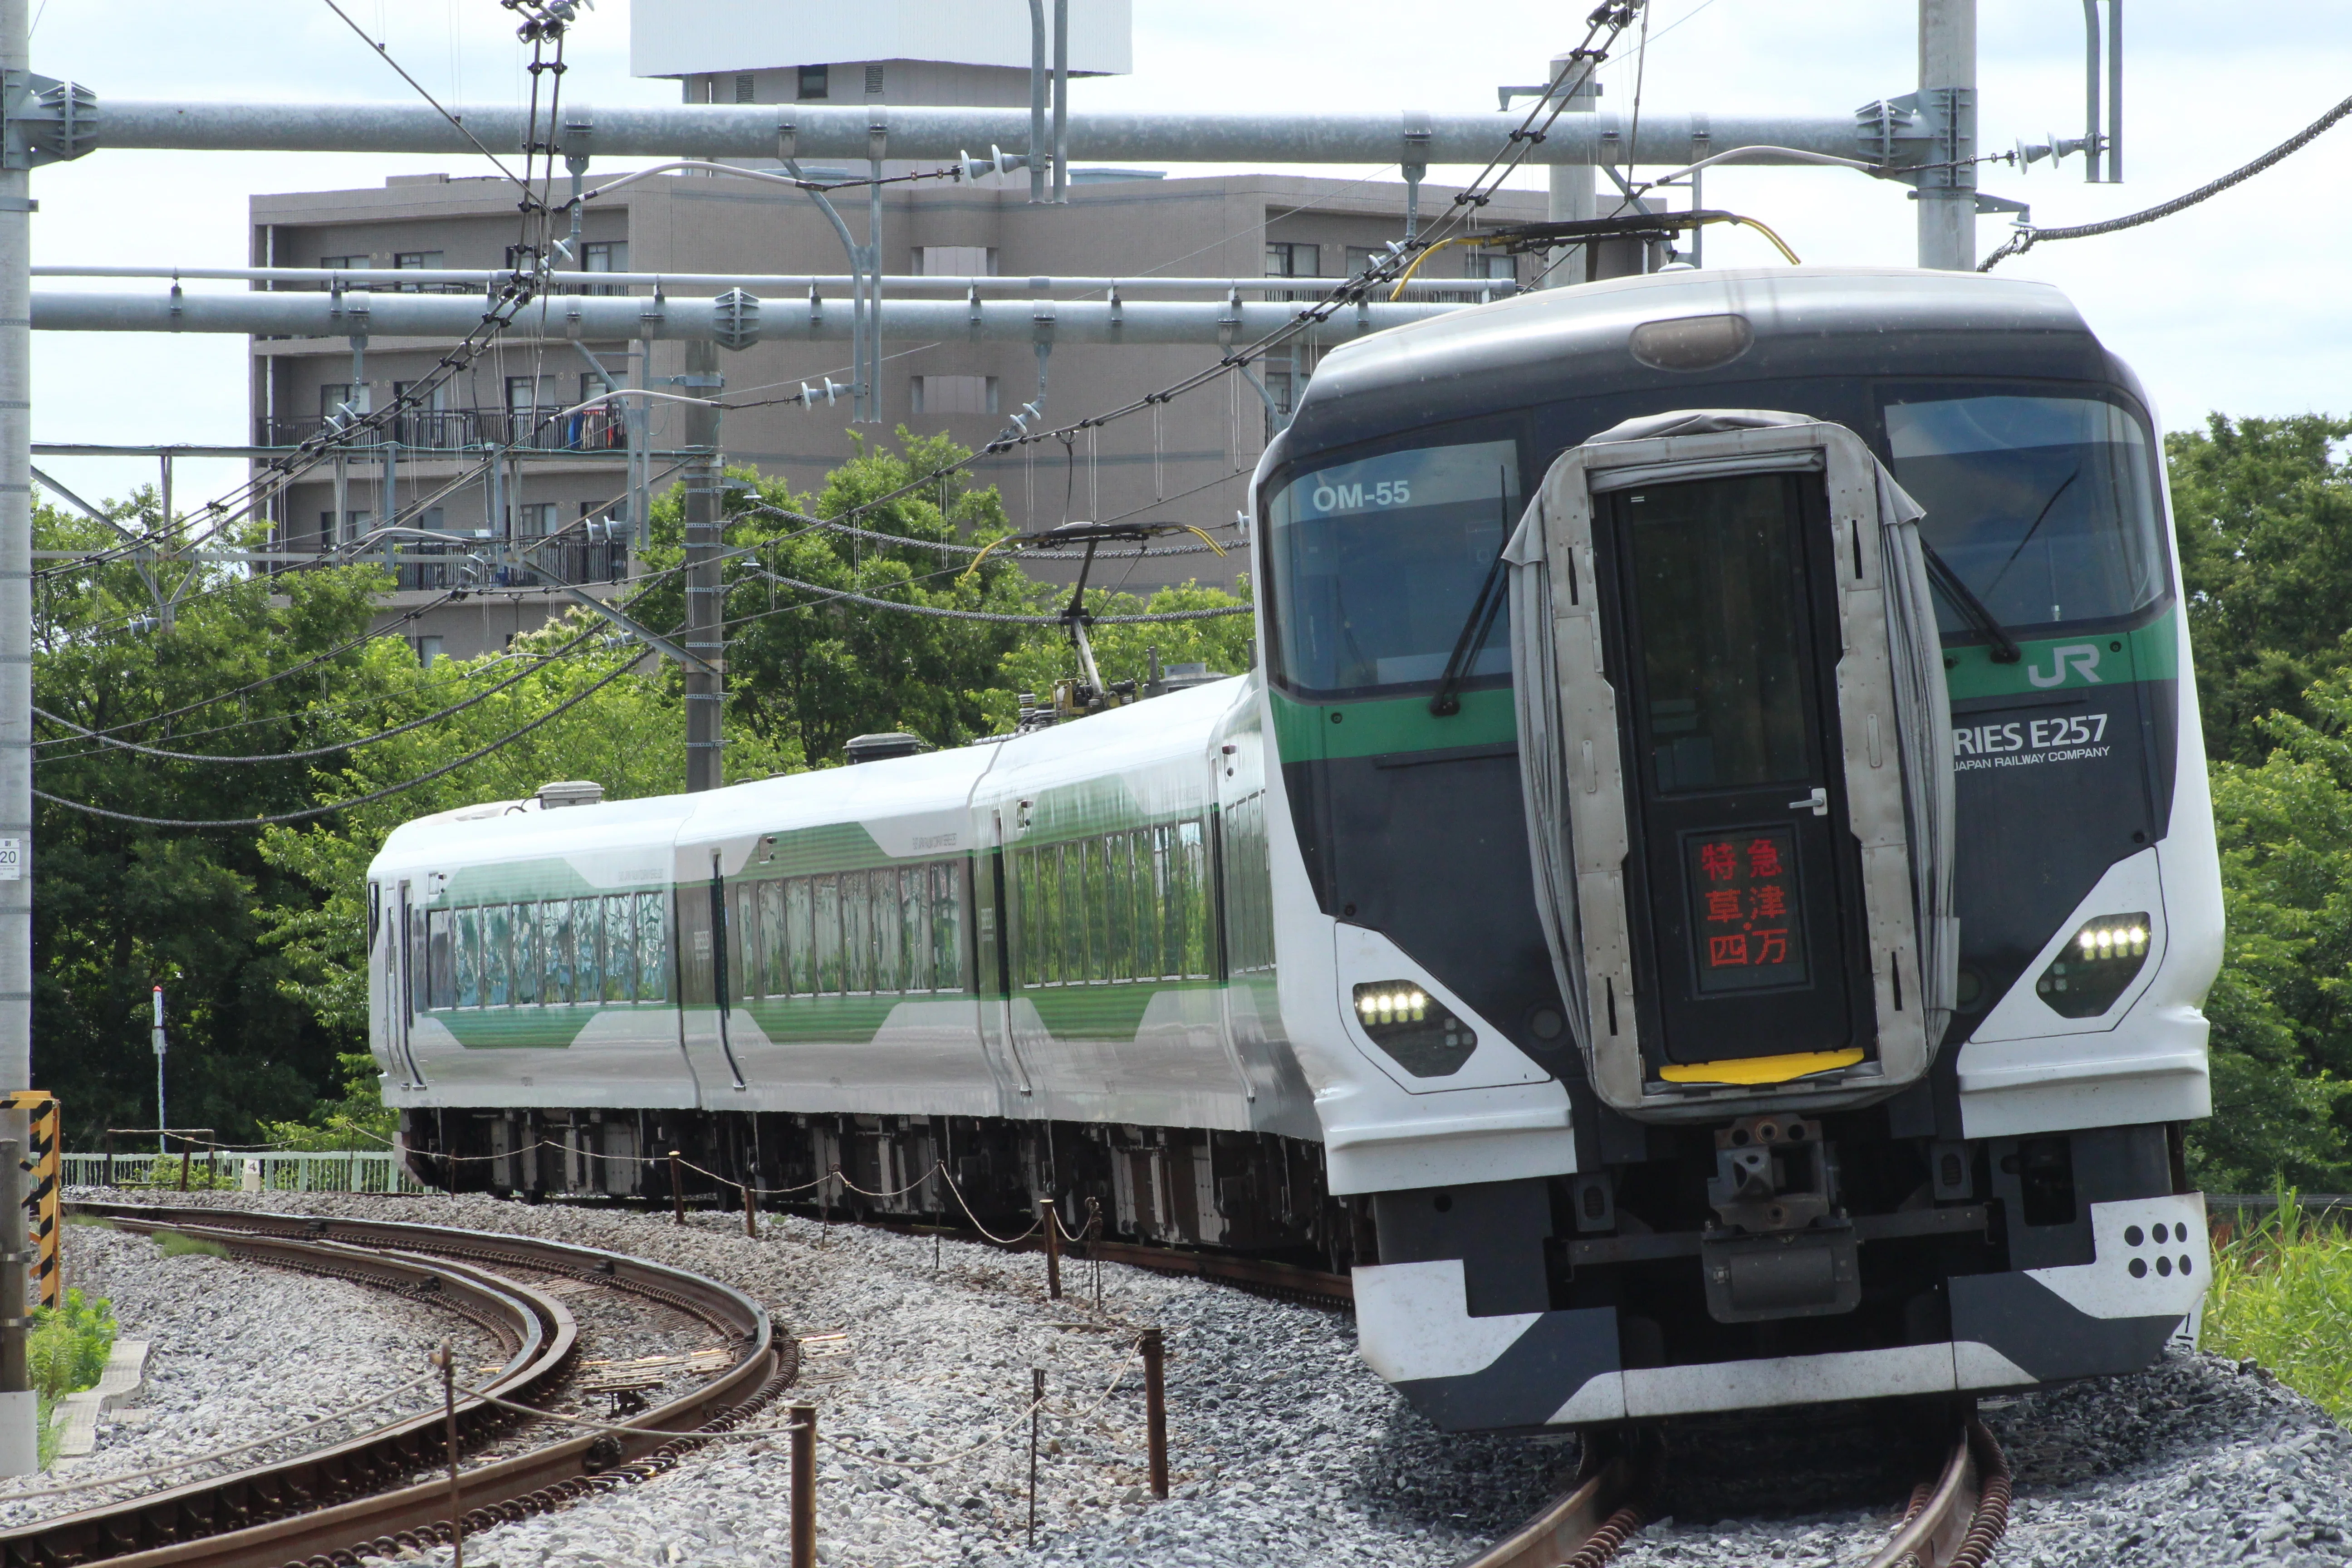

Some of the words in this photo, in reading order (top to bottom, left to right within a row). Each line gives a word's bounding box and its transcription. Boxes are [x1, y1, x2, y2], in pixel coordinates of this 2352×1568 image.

[1313, 480, 1410, 511] OM-55
[2028, 643, 2103, 687] JR
[2030, 713, 2107, 748] E257
[1994, 753, 2046, 768] RAILWAY
[2048, 746, 2111, 762] COMPANY
[1702, 839, 1783, 880] 特急
[1709, 929, 1788, 966] 四万
